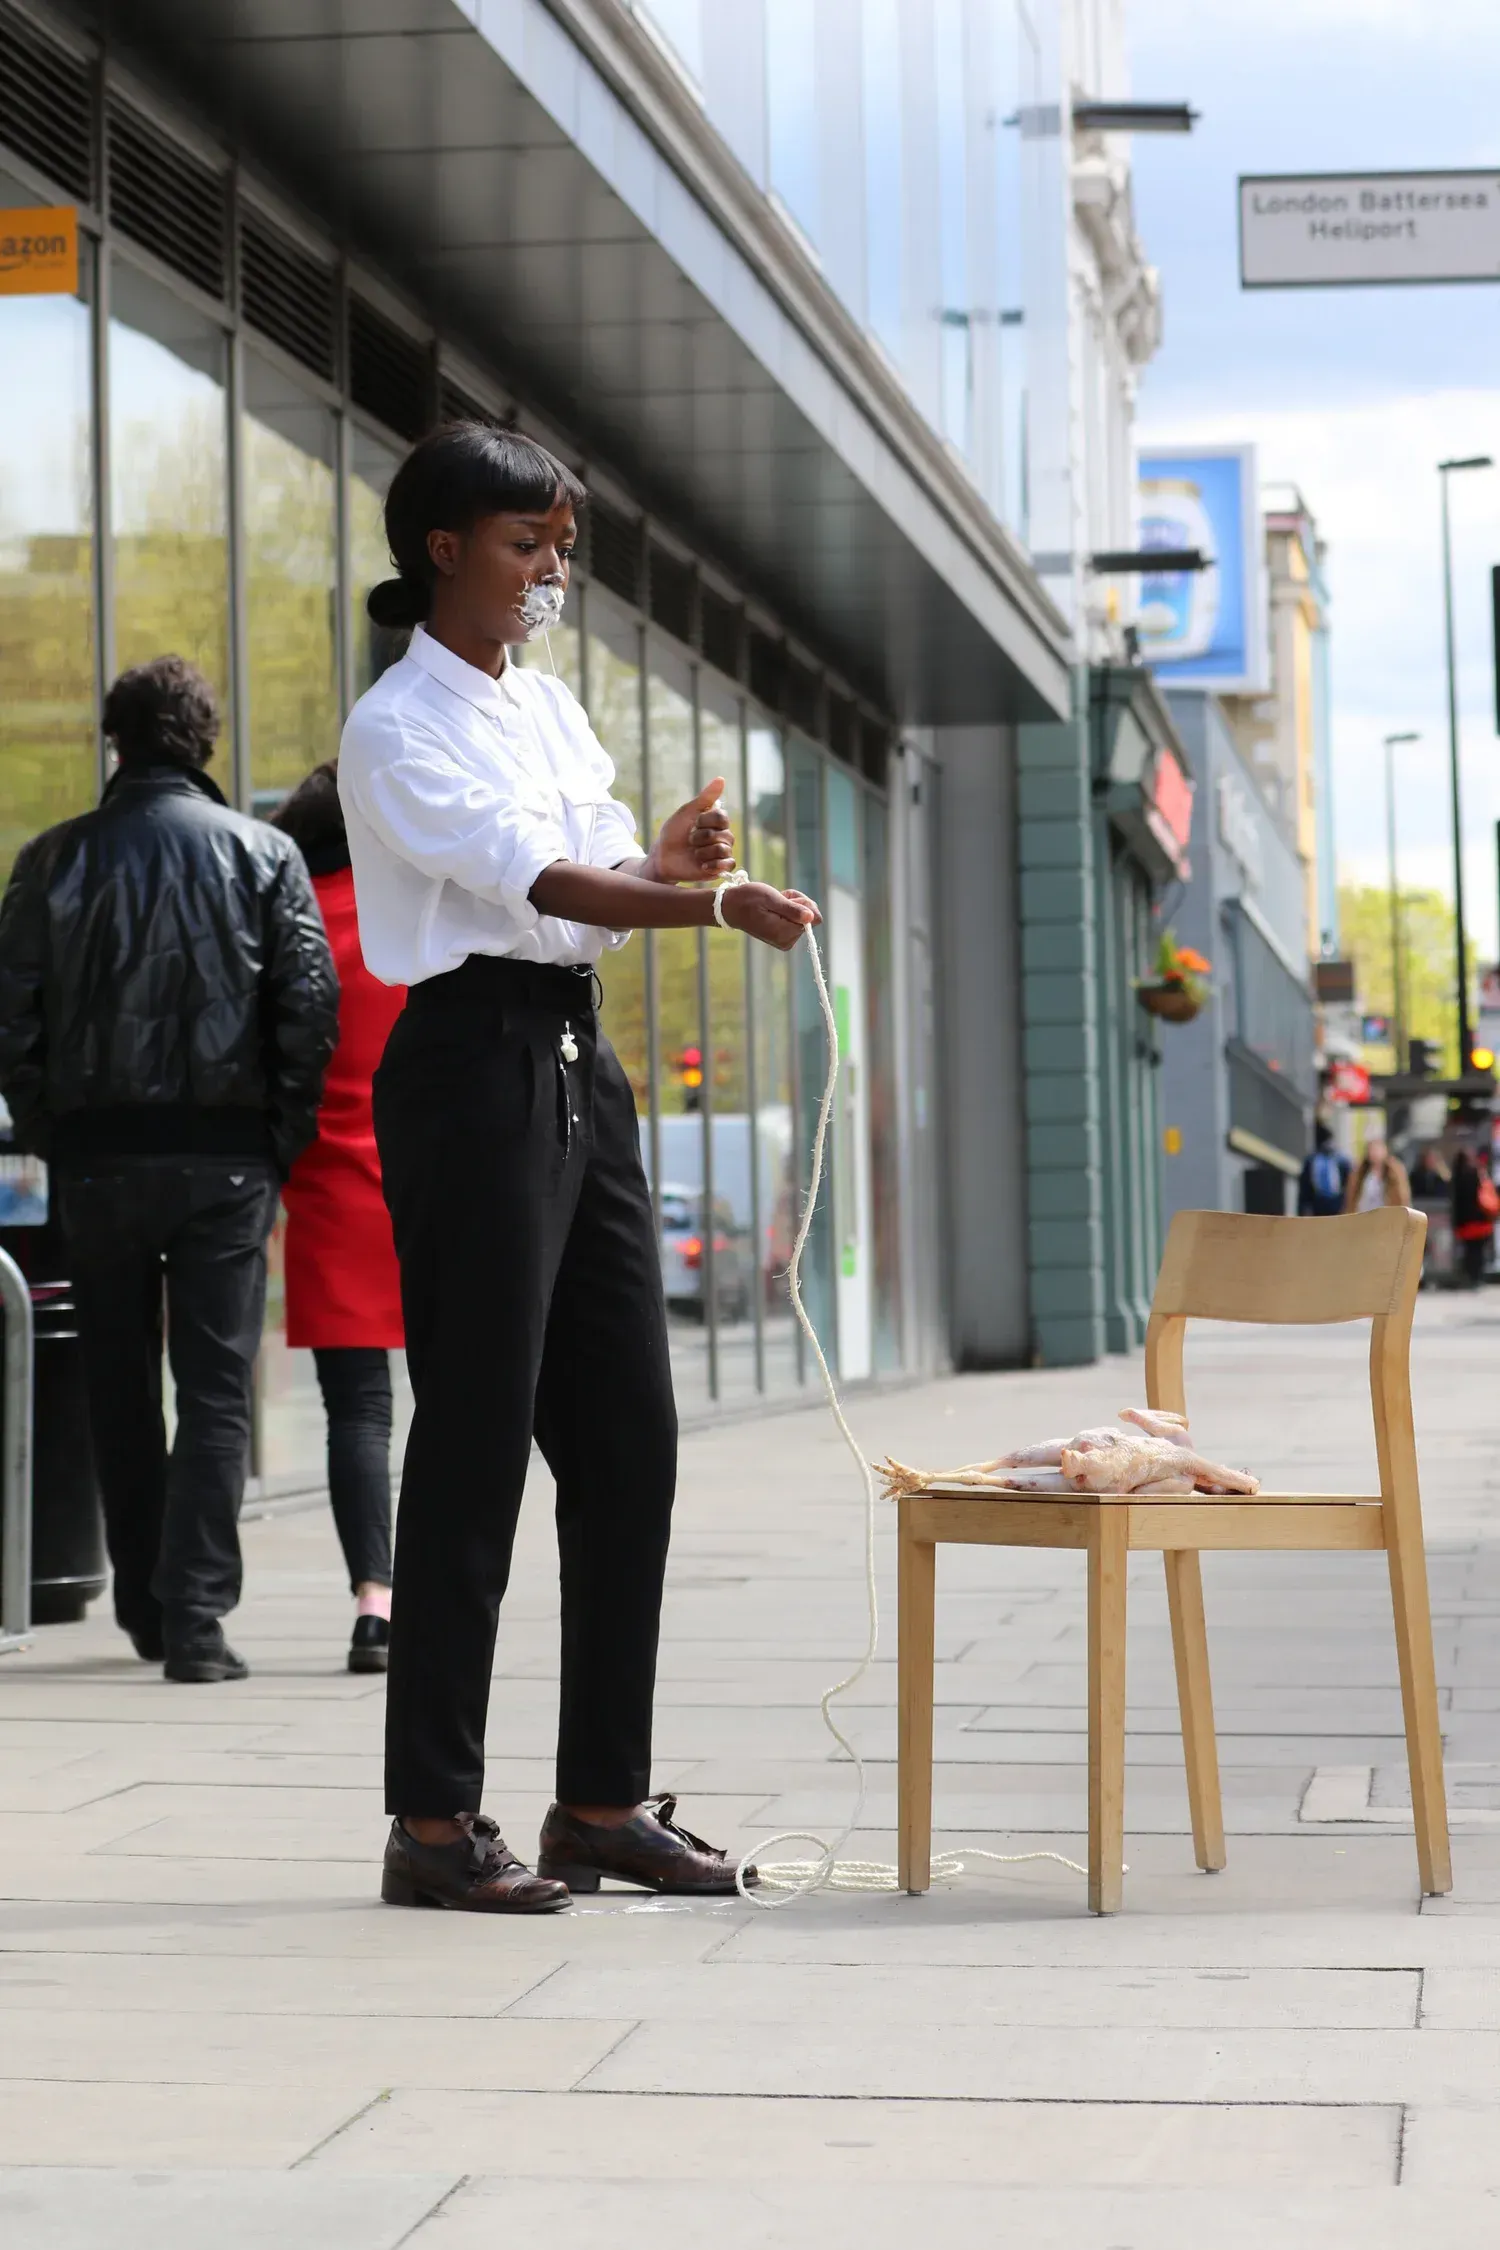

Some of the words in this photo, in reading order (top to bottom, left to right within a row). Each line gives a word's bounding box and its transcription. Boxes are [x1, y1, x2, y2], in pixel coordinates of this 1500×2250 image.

[1252, 192, 1348, 215] London
[1360, 190, 1488, 212] Battersea
[1309, 218, 1417, 240] Heliport
[0, 235, 67, 256] azon
